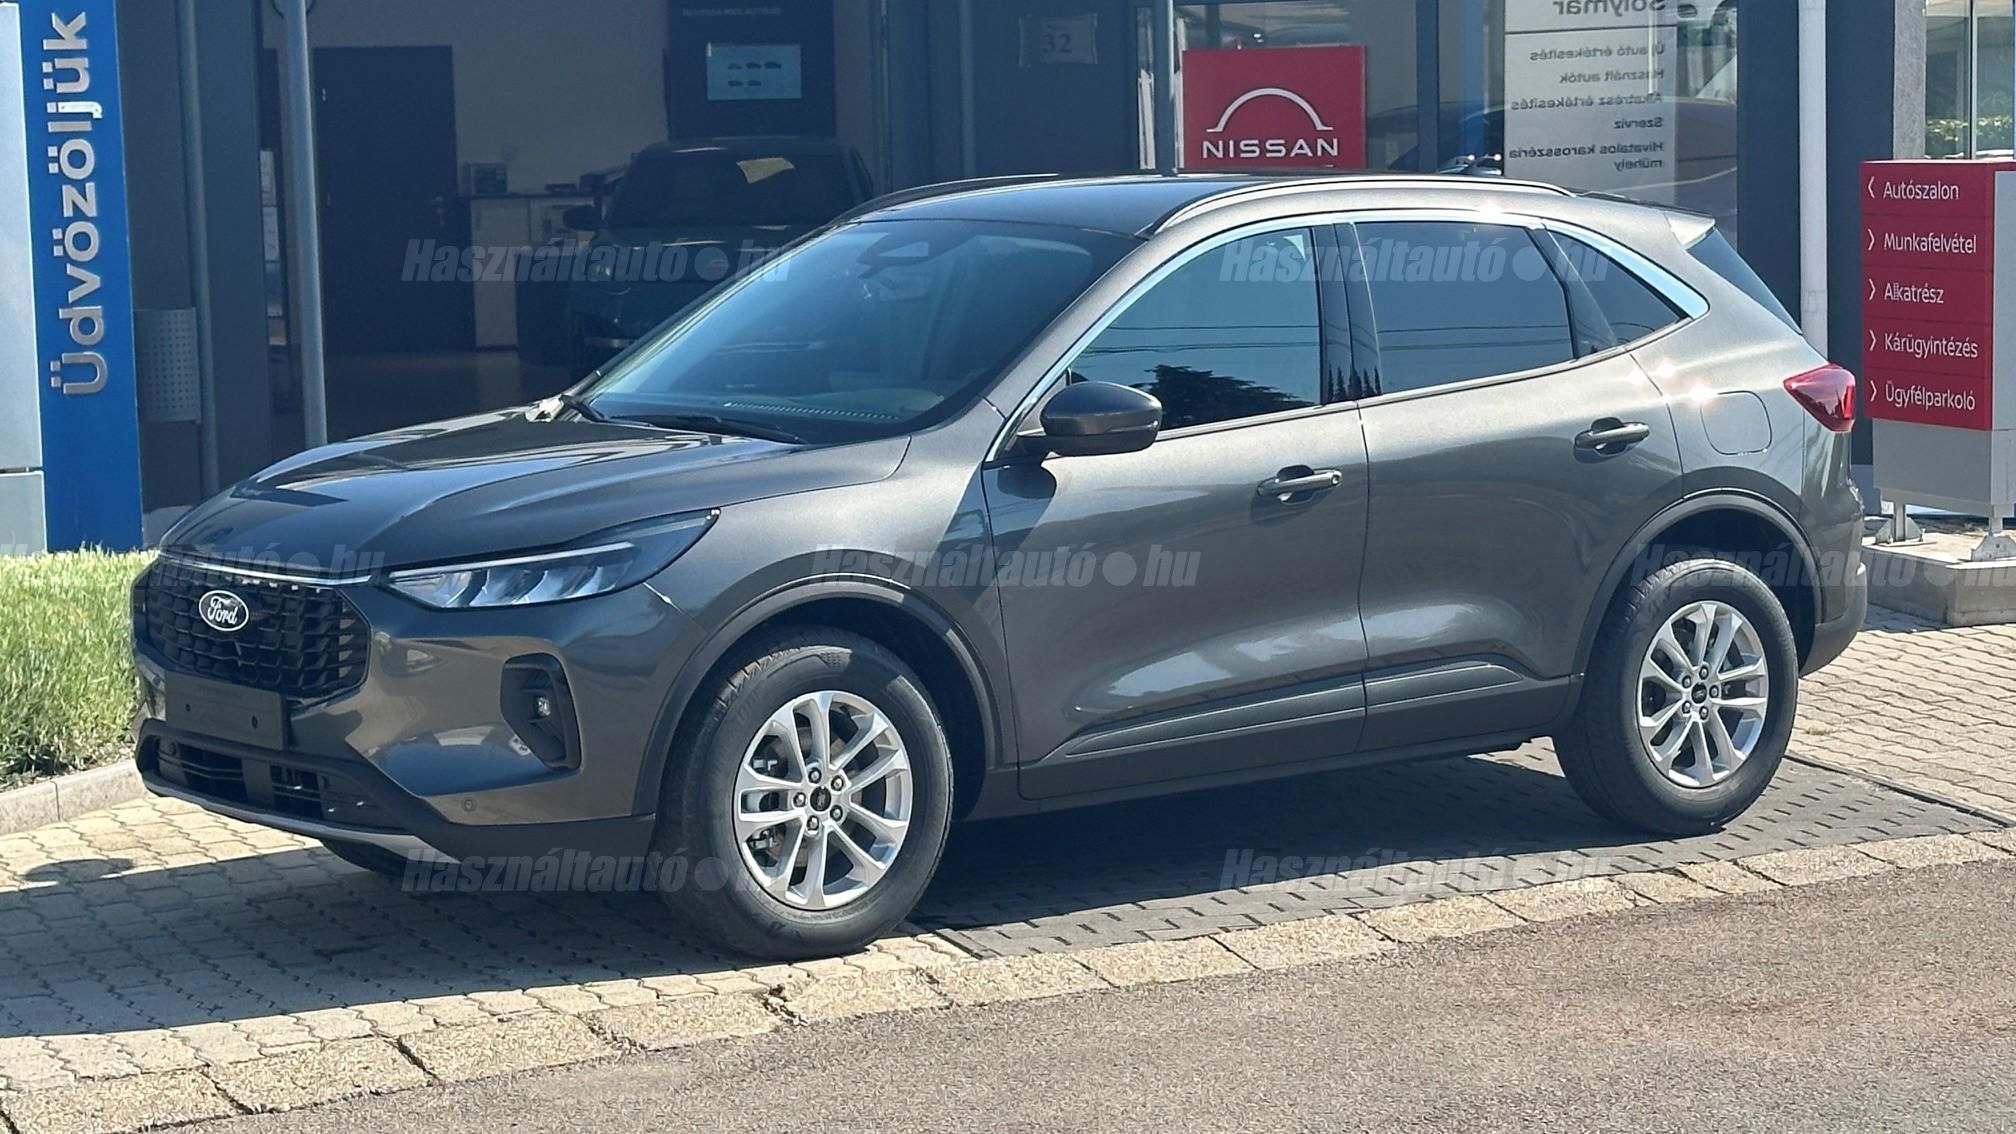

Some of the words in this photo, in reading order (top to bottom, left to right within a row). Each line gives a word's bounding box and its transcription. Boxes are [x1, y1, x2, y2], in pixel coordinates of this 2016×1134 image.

[1042, 33, 1073, 53] 32
[1202, 138, 1338, 159] NISSAN
[1883, 179, 1959, 200] Autószalon
[42, 12, 108, 395] Üdvözöljük
[1883, 232, 1977, 254] Munkafelvétel
[1884, 282, 1944, 304] Alkatrész
[1884, 332, 1979, 359] Kárügyintézés
[1885, 380, 1976, 411] Ügyfélparkoló
[207, 595, 238, 625] Ford
